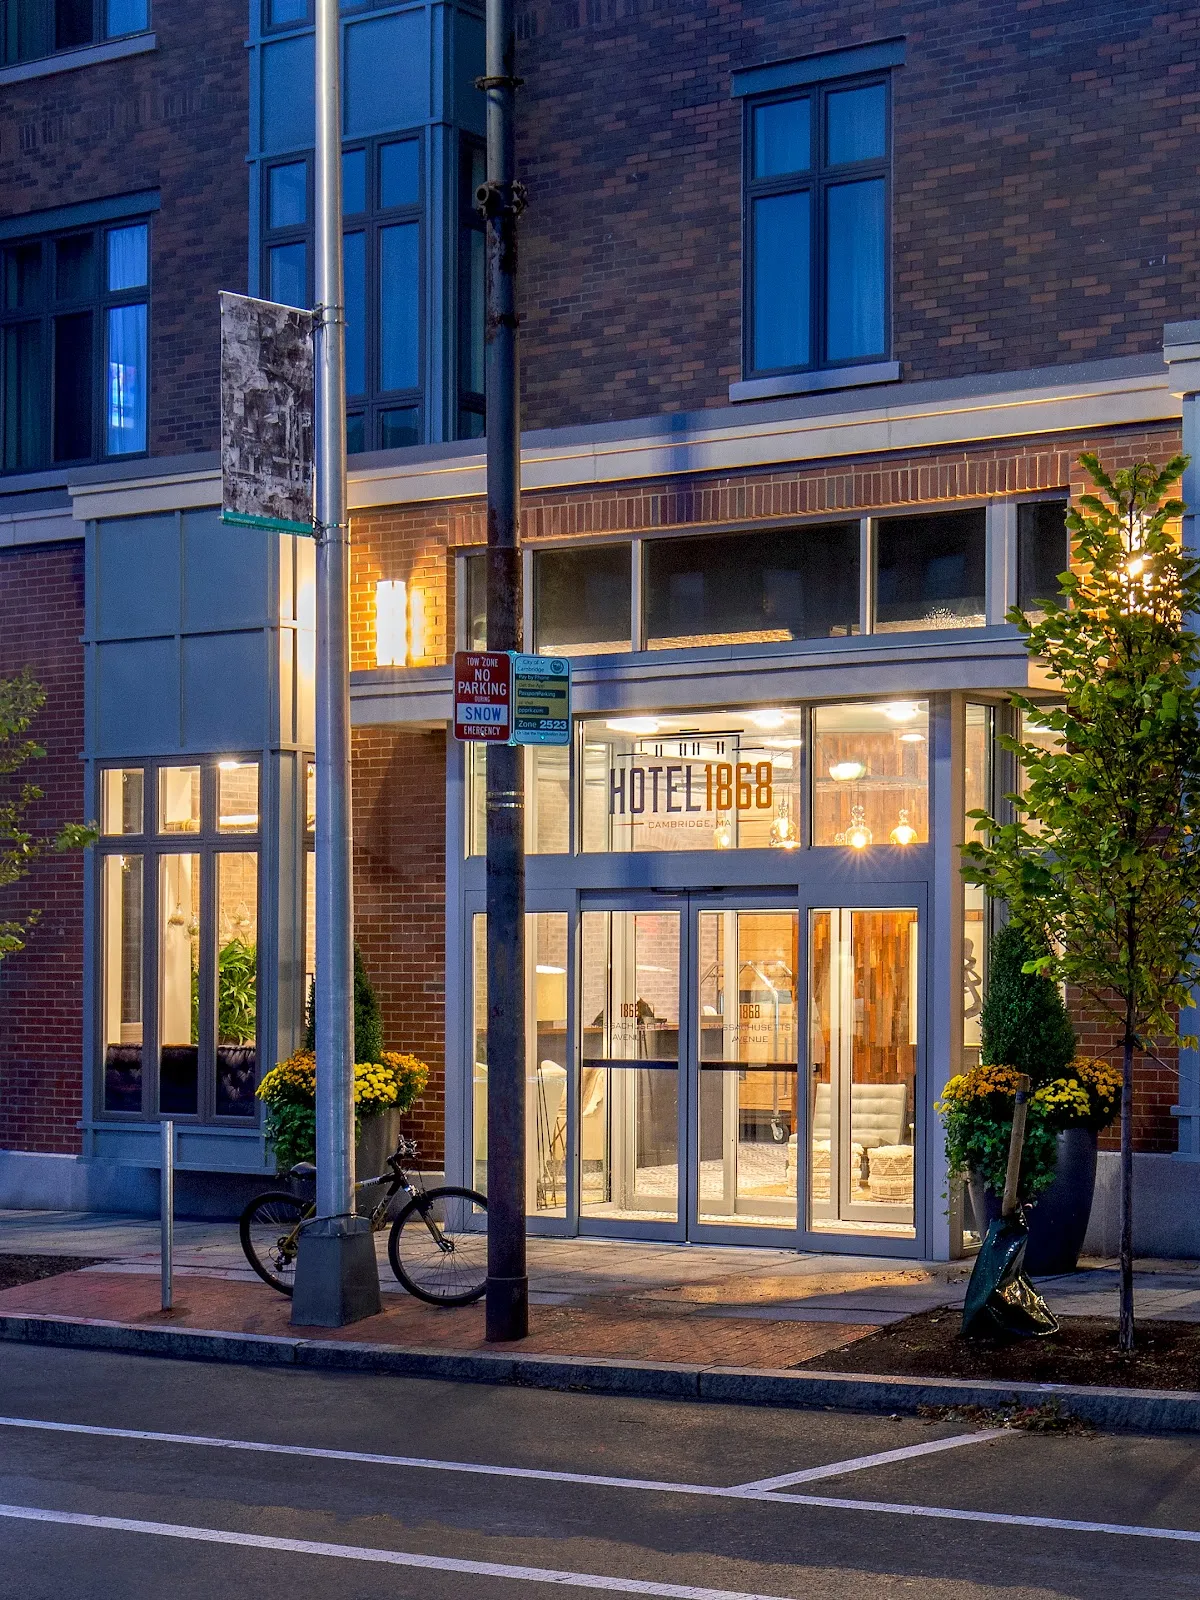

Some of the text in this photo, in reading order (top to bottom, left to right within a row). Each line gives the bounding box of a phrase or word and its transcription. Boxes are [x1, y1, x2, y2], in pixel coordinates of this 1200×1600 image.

[467, 657, 498, 667] TOW ZONE
[475, 669, 490, 681] NO
[458, 681, 507, 696] PARKING
[465, 706, 501, 720] SNOW
[463, 725, 500, 735] EMERGENCY
[518, 720, 567, 730] Zone 2523
[609, 761, 772, 814] HOTEL 1868
[648, 819, 732, 829] CAMBRIDGE, MA
[620, 1003, 639, 1018] 1868
[739, 1004, 760, 1019] 1868
